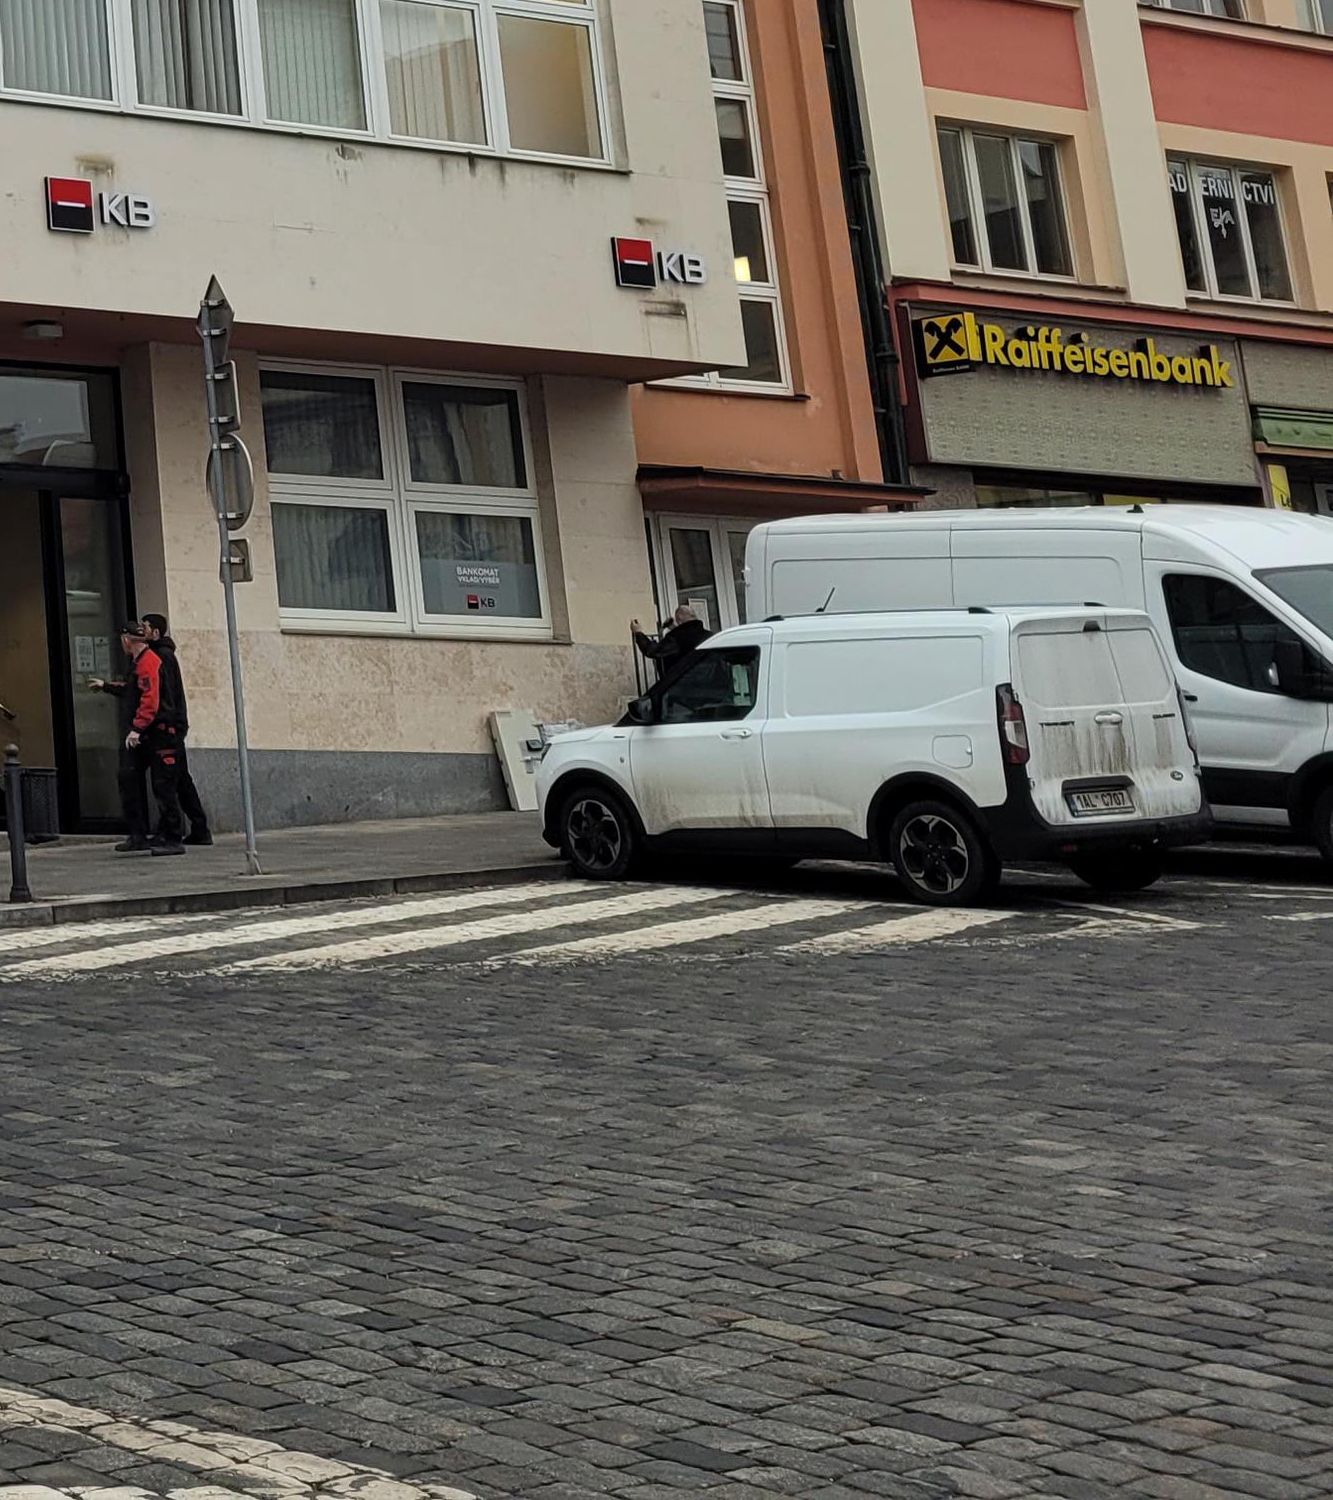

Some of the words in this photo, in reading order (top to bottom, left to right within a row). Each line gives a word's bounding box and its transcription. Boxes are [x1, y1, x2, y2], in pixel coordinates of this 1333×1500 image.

[99, 190, 155, 228] KB
[657, 251, 708, 285] KB
[984, 323, 1234, 388] Raiffeisenbank
[456, 566, 500, 577] BANKOMAT
[480, 598, 496, 608] KB
[1076, 794, 1098, 808] 1AL
[1100, 792, 1126, 807] C707
